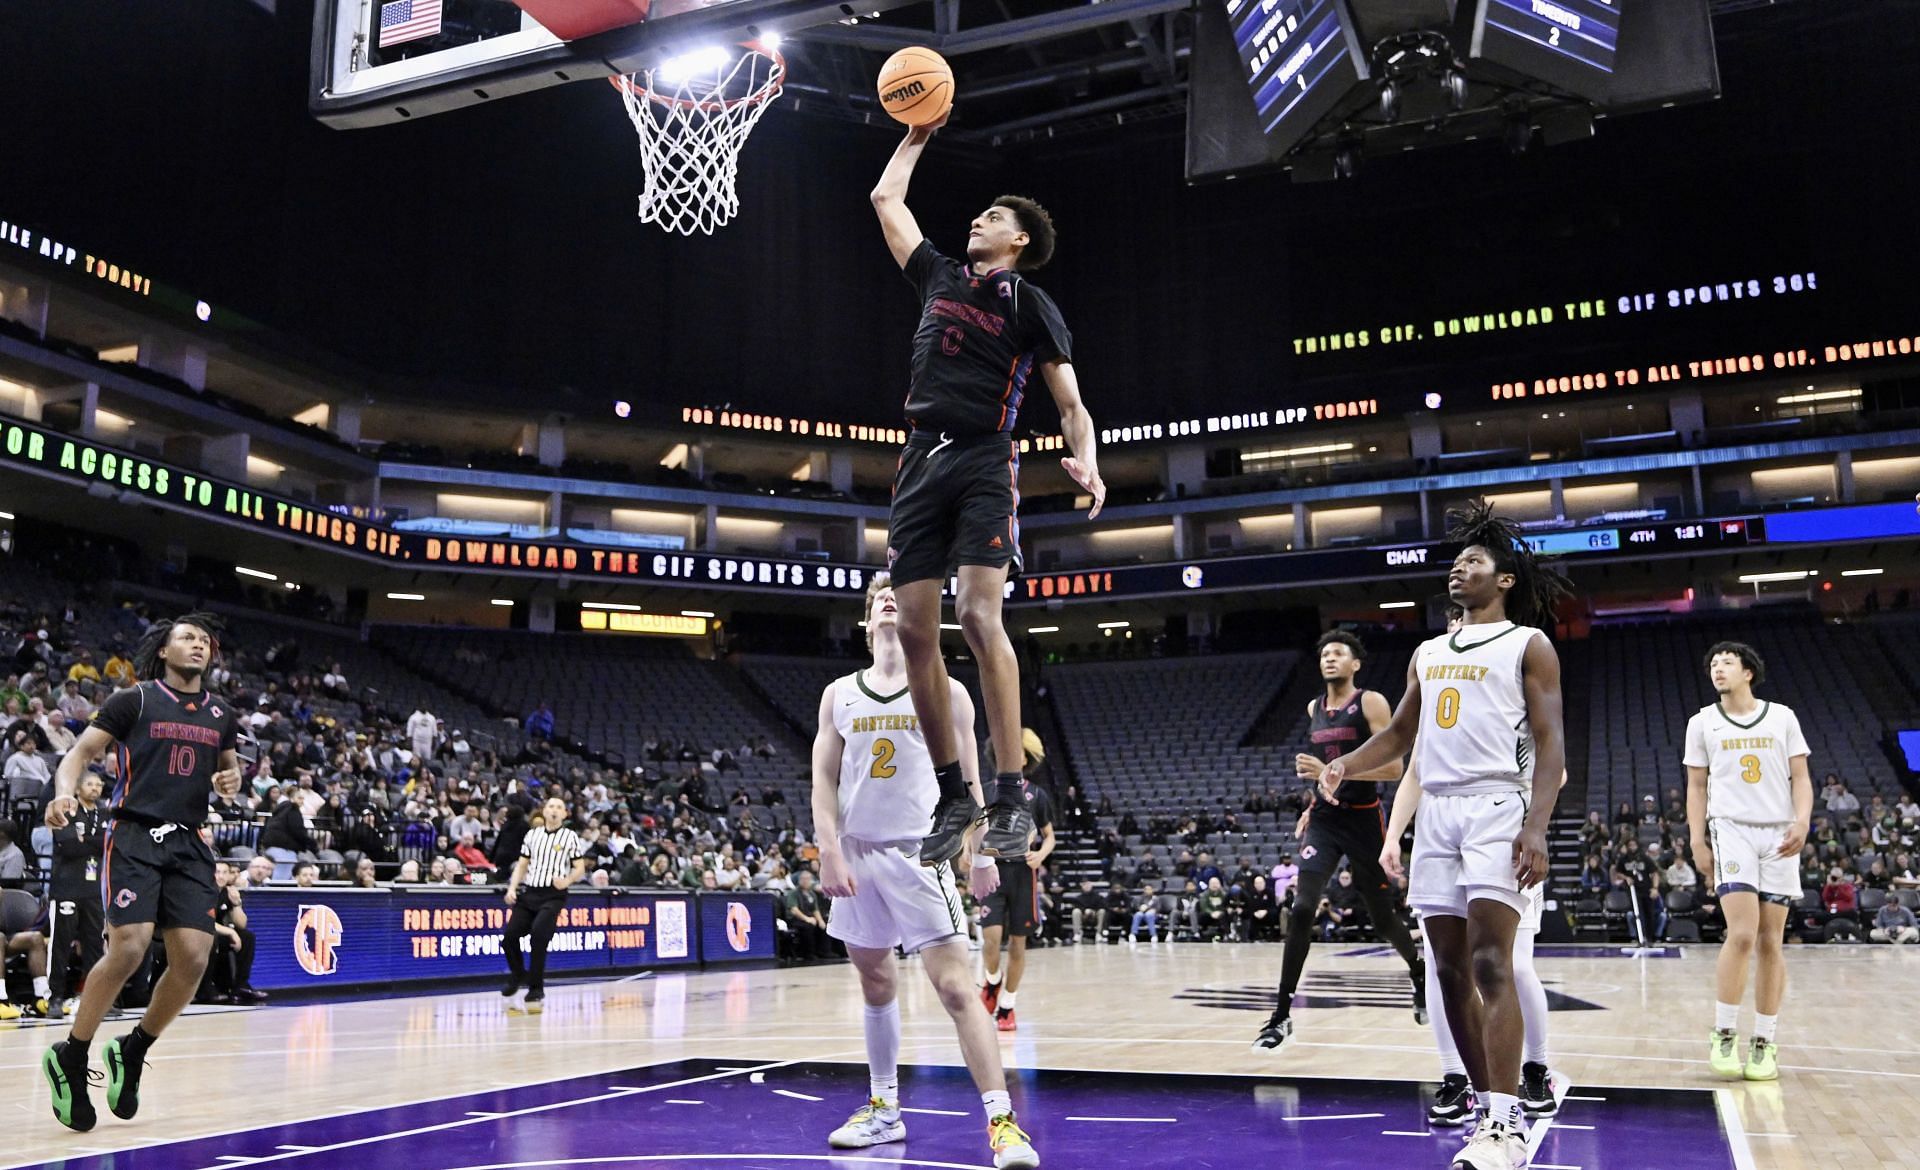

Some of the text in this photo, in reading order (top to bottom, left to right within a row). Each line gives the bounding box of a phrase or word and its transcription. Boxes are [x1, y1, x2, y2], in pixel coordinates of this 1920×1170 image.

[1549, 26, 1560, 46] 2
[881, 80, 926, 103] Wilson
[1297, 74, 1306, 90] 1
[40, 237, 76, 265] APP
[1293, 330, 1369, 355] THINGS
[1380, 325, 1423, 344] CIF.
[1433, 307, 1553, 337] DOWNLOAD
[1565, 299, 1606, 320] THE
[1618, 293, 1655, 314] CIF
[1667, 279, 1760, 307] SPORTS
[1614, 369, 1639, 386] TO
[1648, 364, 1681, 382] ALL
[720, 411, 783, 432] ACCESS
[789, 418, 809, 434] TO
[815, 422, 842, 438] ALL
[1275, 407, 1307, 424] APP
[0, 422, 45, 461] OR
[60, 441, 170, 495] ACCESS
[183, 475, 213, 506] TO
[225, 488, 264, 521] ALL
[277, 502, 356, 545] THINGS
[366, 528, 410, 559] CIF.
[426, 538, 577, 570] DOWNLOAD
[592, 551, 639, 574] THE
[652, 554, 695, 578] CIF
[708, 558, 804, 586] SPORTS
[816, 566, 863, 590] 365
[1026, 573, 1112, 598] TODAY!
[1386, 548, 1428, 565] CHAT
[1589, 533, 1612, 548] 68
[1629, 530, 1656, 543] 4TH
[1425, 664, 1489, 682] MONTEREY
[1436, 687, 1461, 730] 0
[852, 714, 919, 733] MONTEREY
[1721, 736, 1775, 750] MONTEREY
[168, 744, 196, 777] 10
[870, 737, 897, 779] 2
[1739, 754, 1762, 784] 3
[403, 908, 431, 931] FOR
[433, 908, 484, 930] ACCESS
[486, 908, 504, 929] TO
[411, 936, 438, 958] THE
[440, 935, 463, 957] CIF
[585, 931, 606, 950] APP
